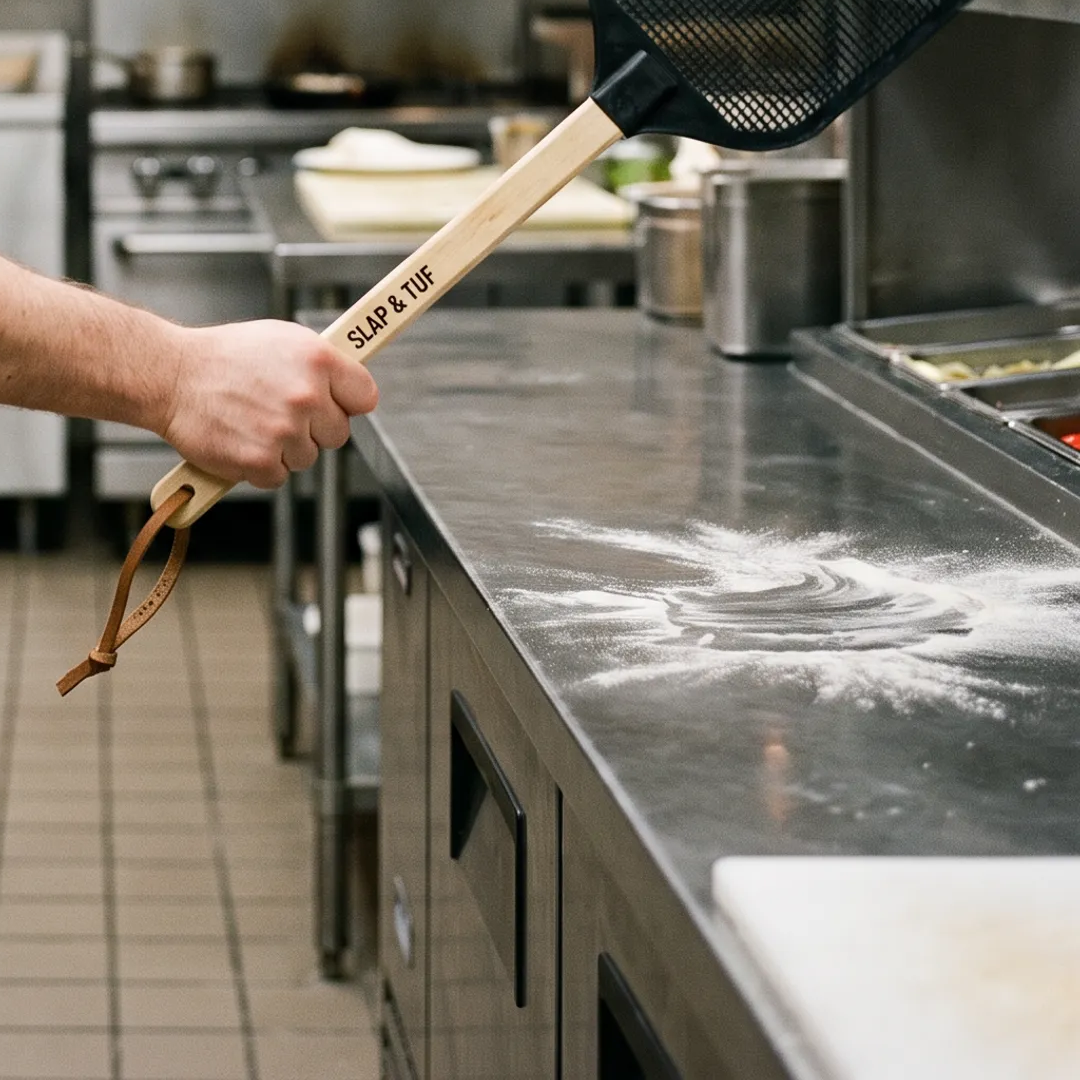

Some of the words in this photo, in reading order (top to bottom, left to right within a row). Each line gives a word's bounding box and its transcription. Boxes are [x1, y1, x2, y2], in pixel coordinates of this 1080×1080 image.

[347, 305, 388, 349] SLAP
[387, 295, 407, 313] &
[400, 264, 435, 300] TUF
